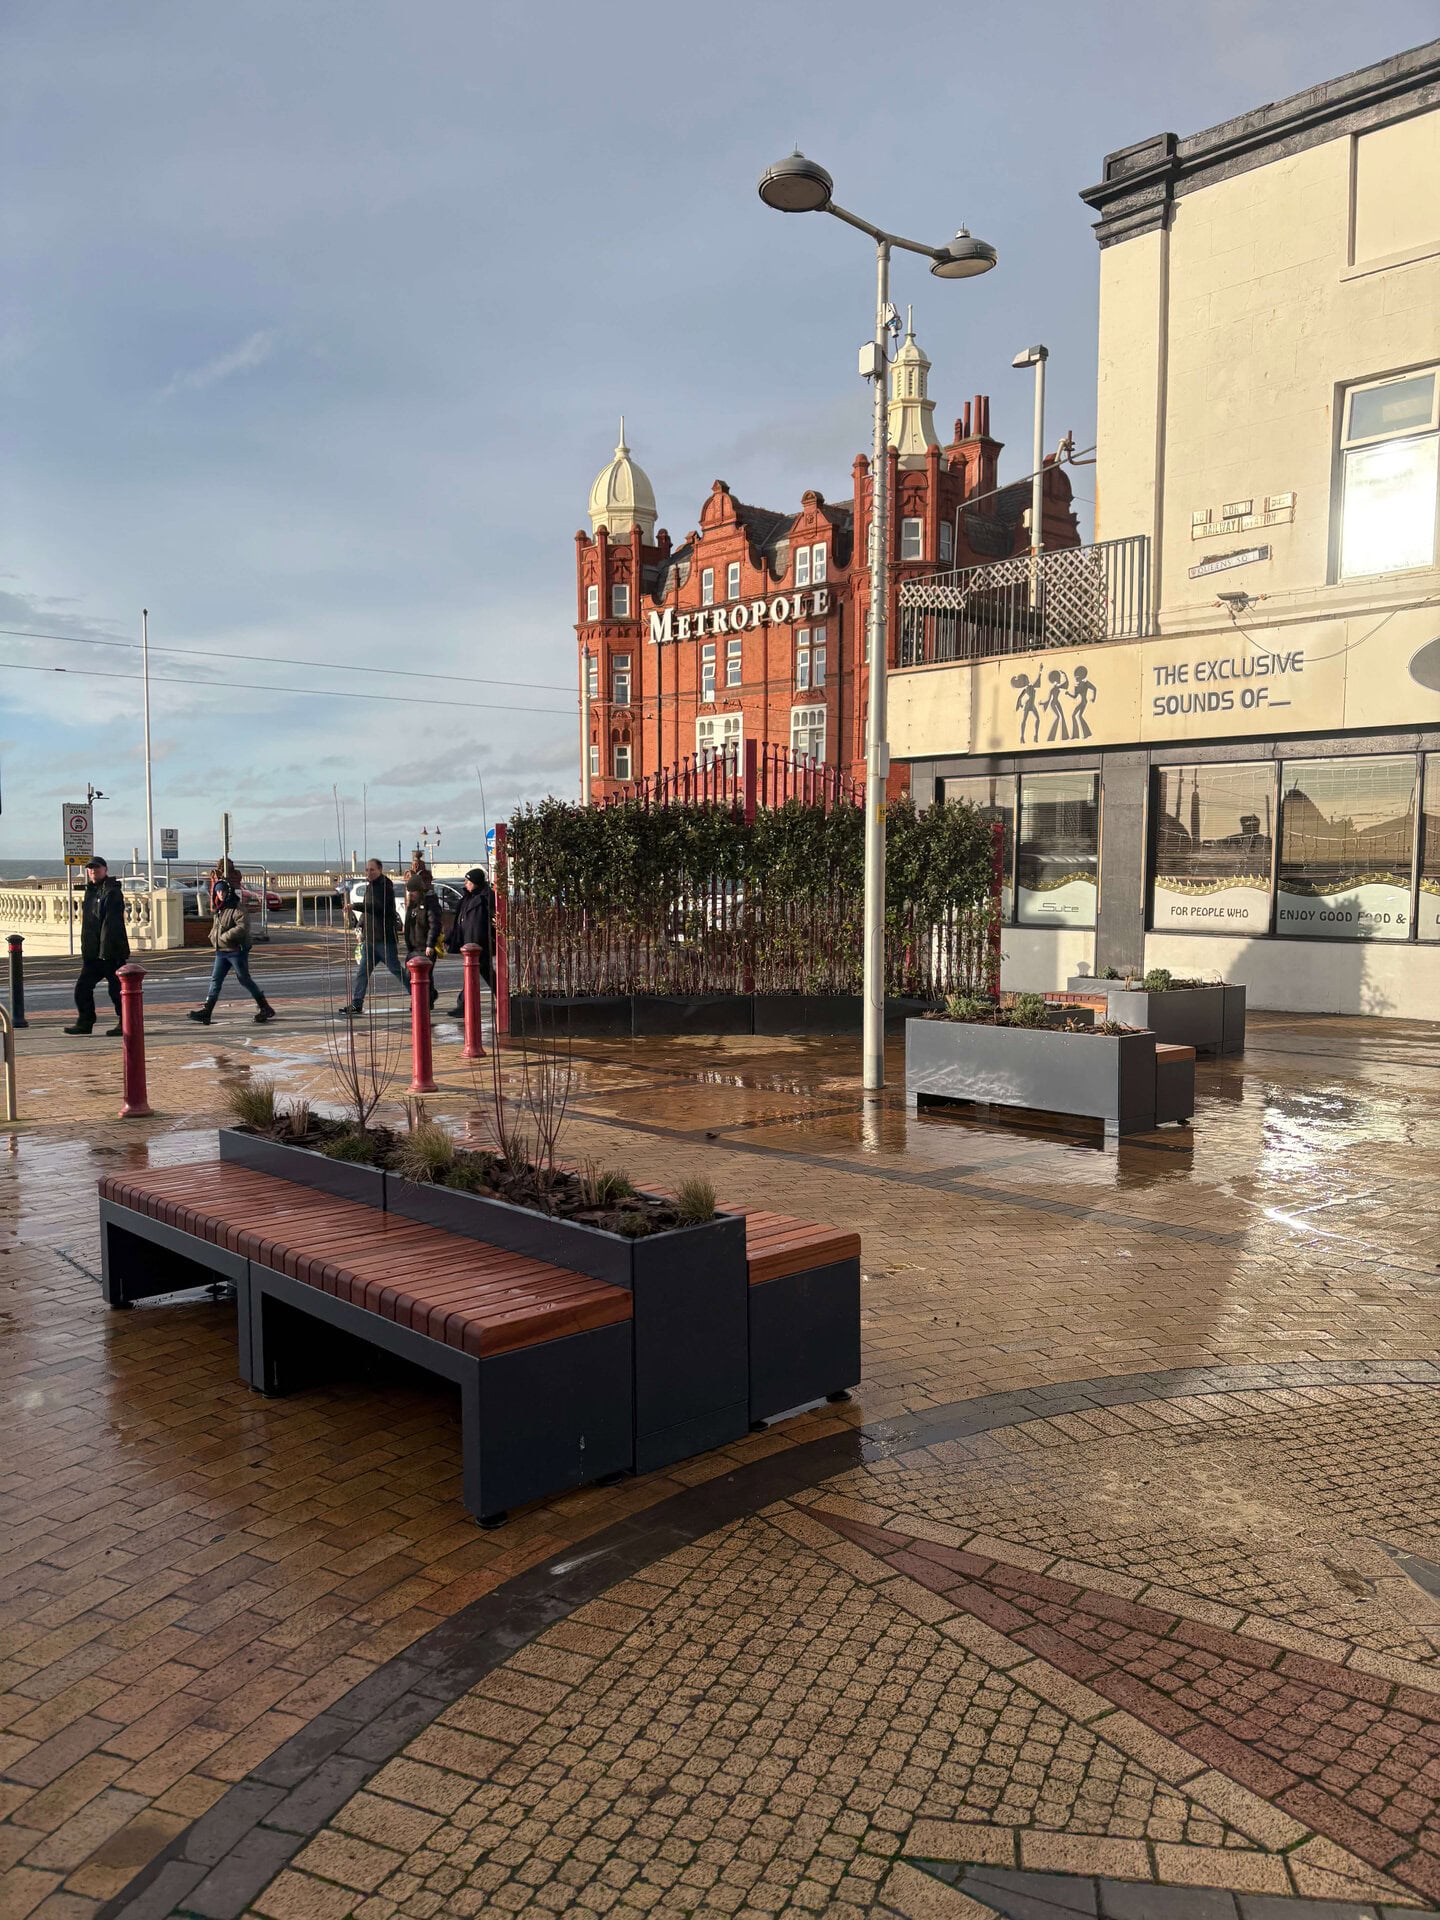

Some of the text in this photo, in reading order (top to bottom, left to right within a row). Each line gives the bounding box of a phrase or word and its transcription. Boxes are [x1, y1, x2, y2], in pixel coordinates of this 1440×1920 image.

[1202, 519, 1236, 536] RAILWAY
[1197, 559, 1232, 575] QUEENS
[1153, 650, 1304, 686] THE EXCLUSIVE
[1153, 689, 1234, 716] SOUNDS
[1170, 906, 1249, 918] FOR PEOPLE WHO
[1279, 909, 1407, 924] ENJOY GOOD FOOD &
